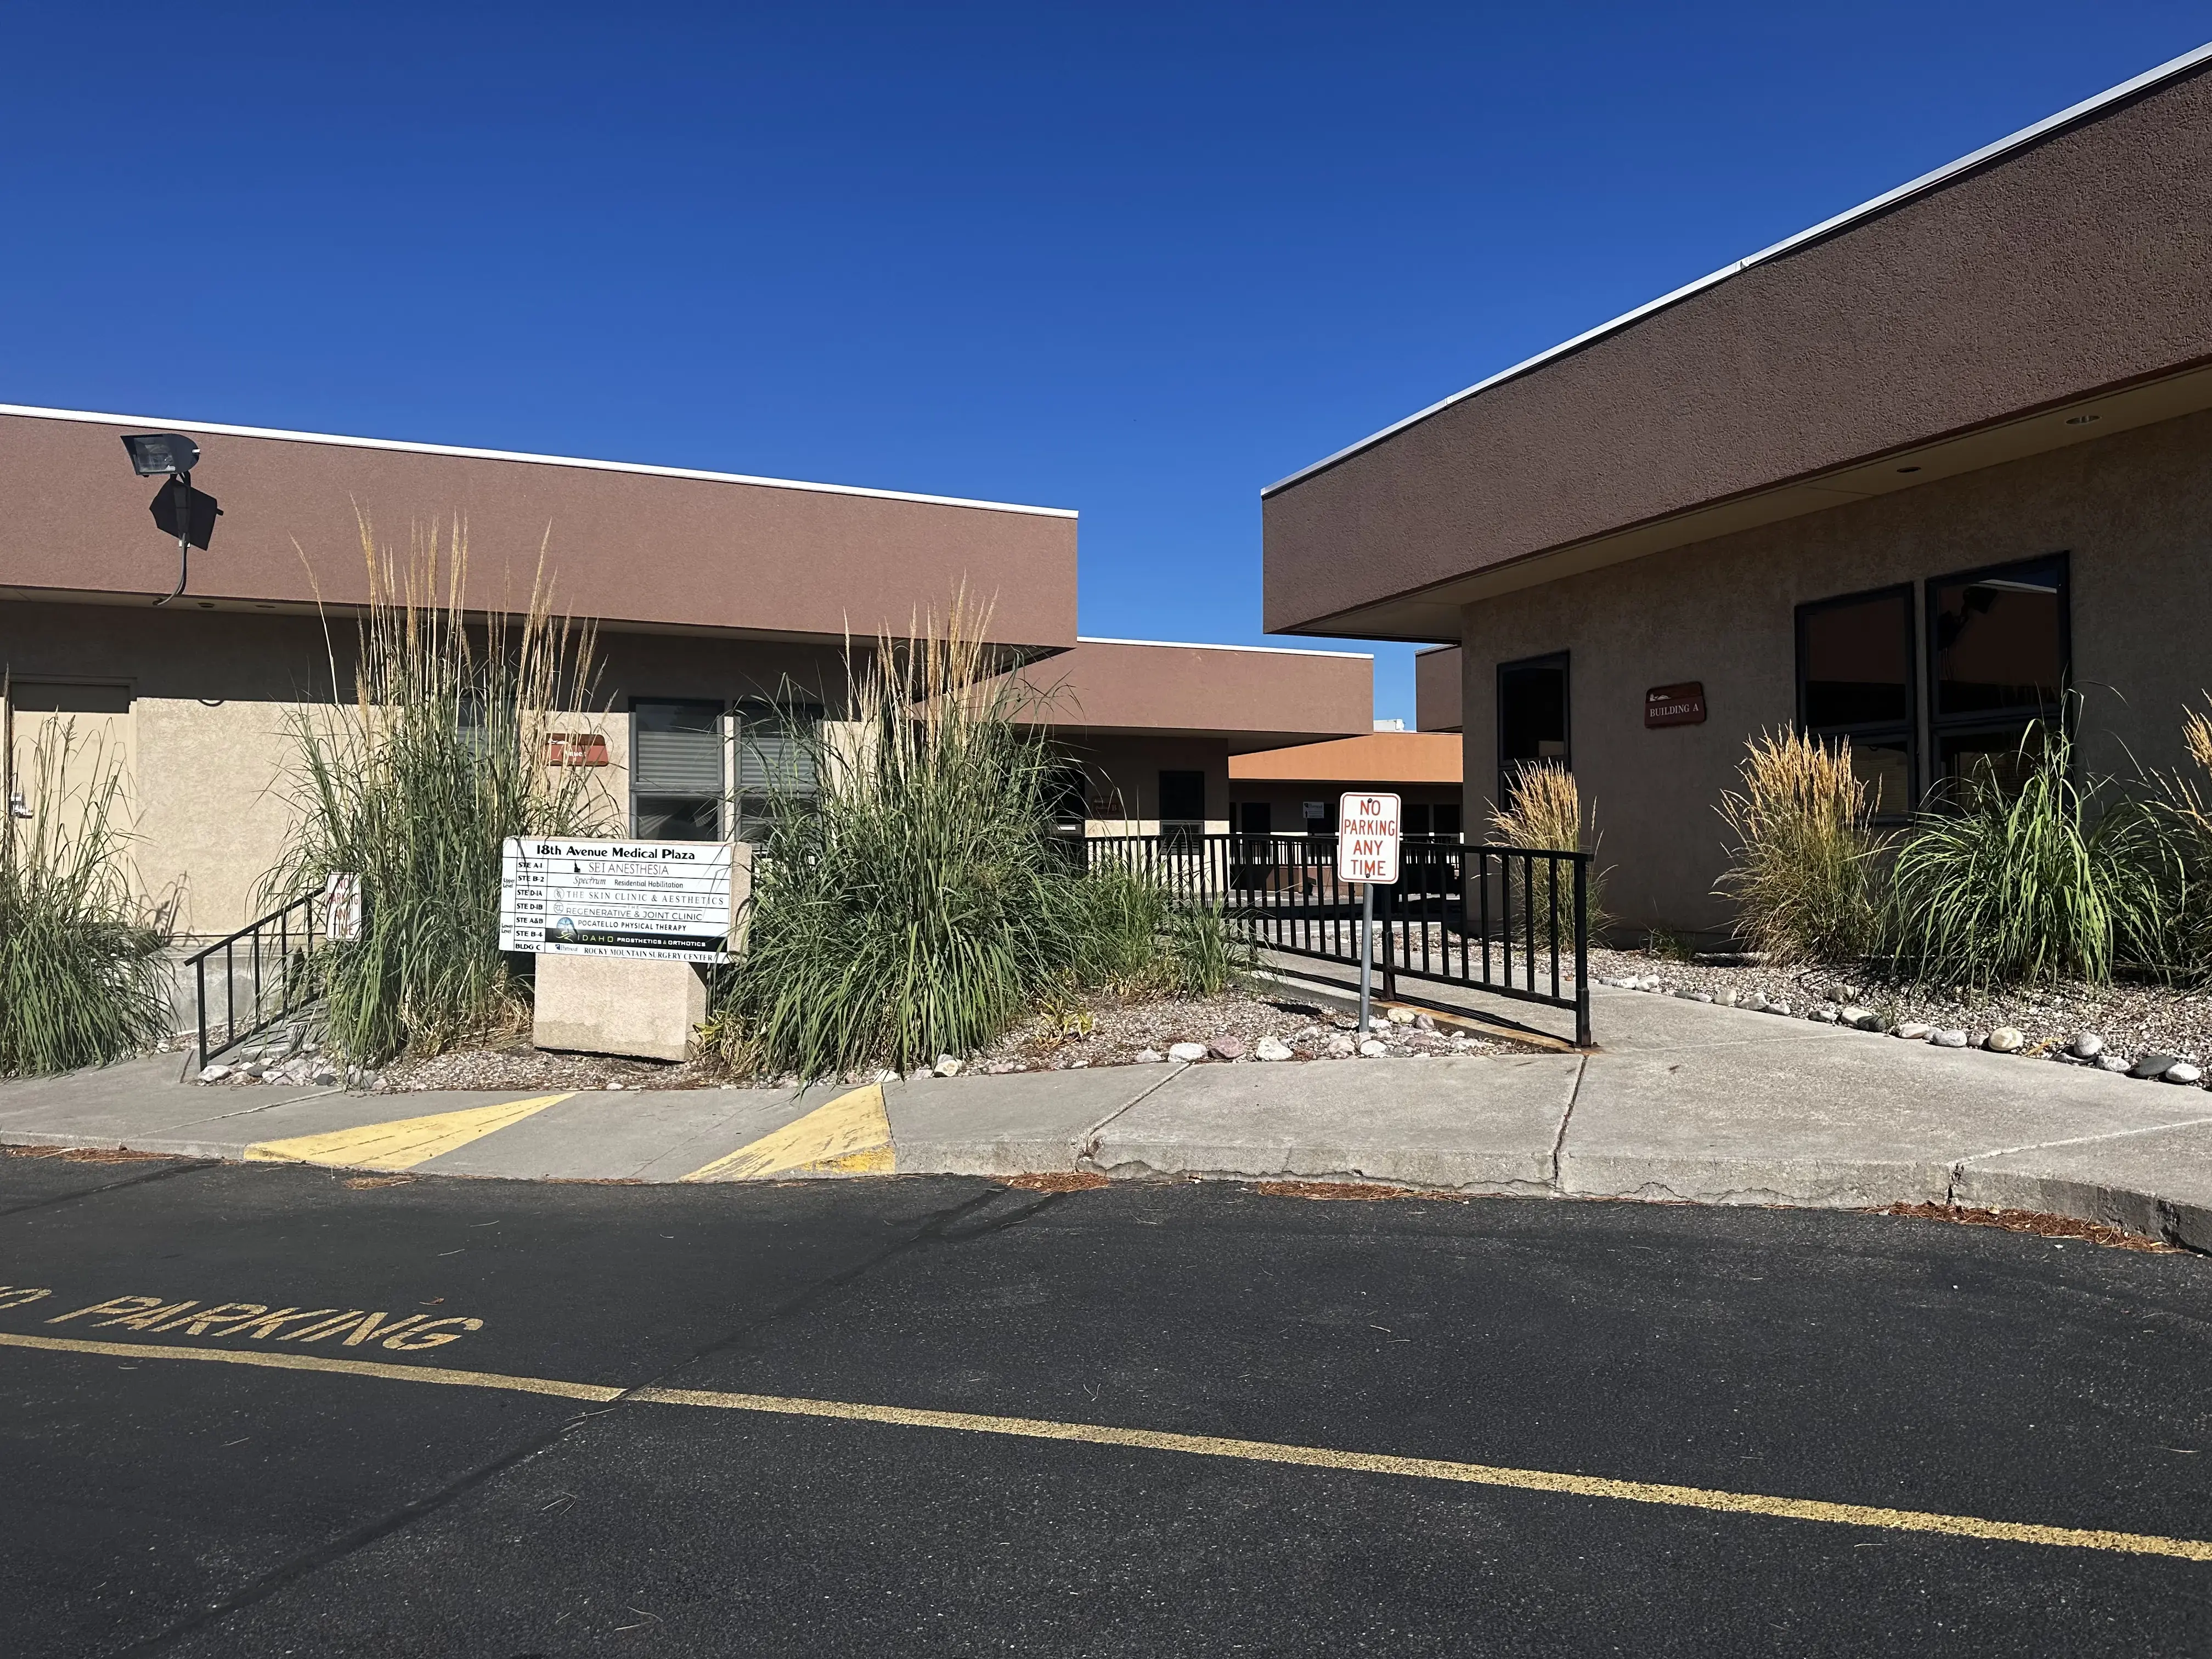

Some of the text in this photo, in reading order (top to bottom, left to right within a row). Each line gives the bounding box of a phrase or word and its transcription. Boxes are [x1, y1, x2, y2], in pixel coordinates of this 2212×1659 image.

[1650, 704, 1689, 716] BUILDING
[1360, 800, 1381, 816] NO
[1344, 819, 1395, 836] PARKING
[537, 845, 695, 860] 18th Avenue Medical Plaza
[1353, 840, 1383, 855] ANY
[589, 862, 669, 875] SEI ANESTHESIA
[1351, 860, 1386, 876] TIME
[573, 876, 606, 886] Spectrum
[662, 895, 724, 905] AESTHETICS
[566, 907, 631, 917] REGENERATIVE
[672, 912, 703, 921] CLINIC
[610, 949, 647, 957] MOUNTAIN
[44, 1295, 483, 1350] PARKING
